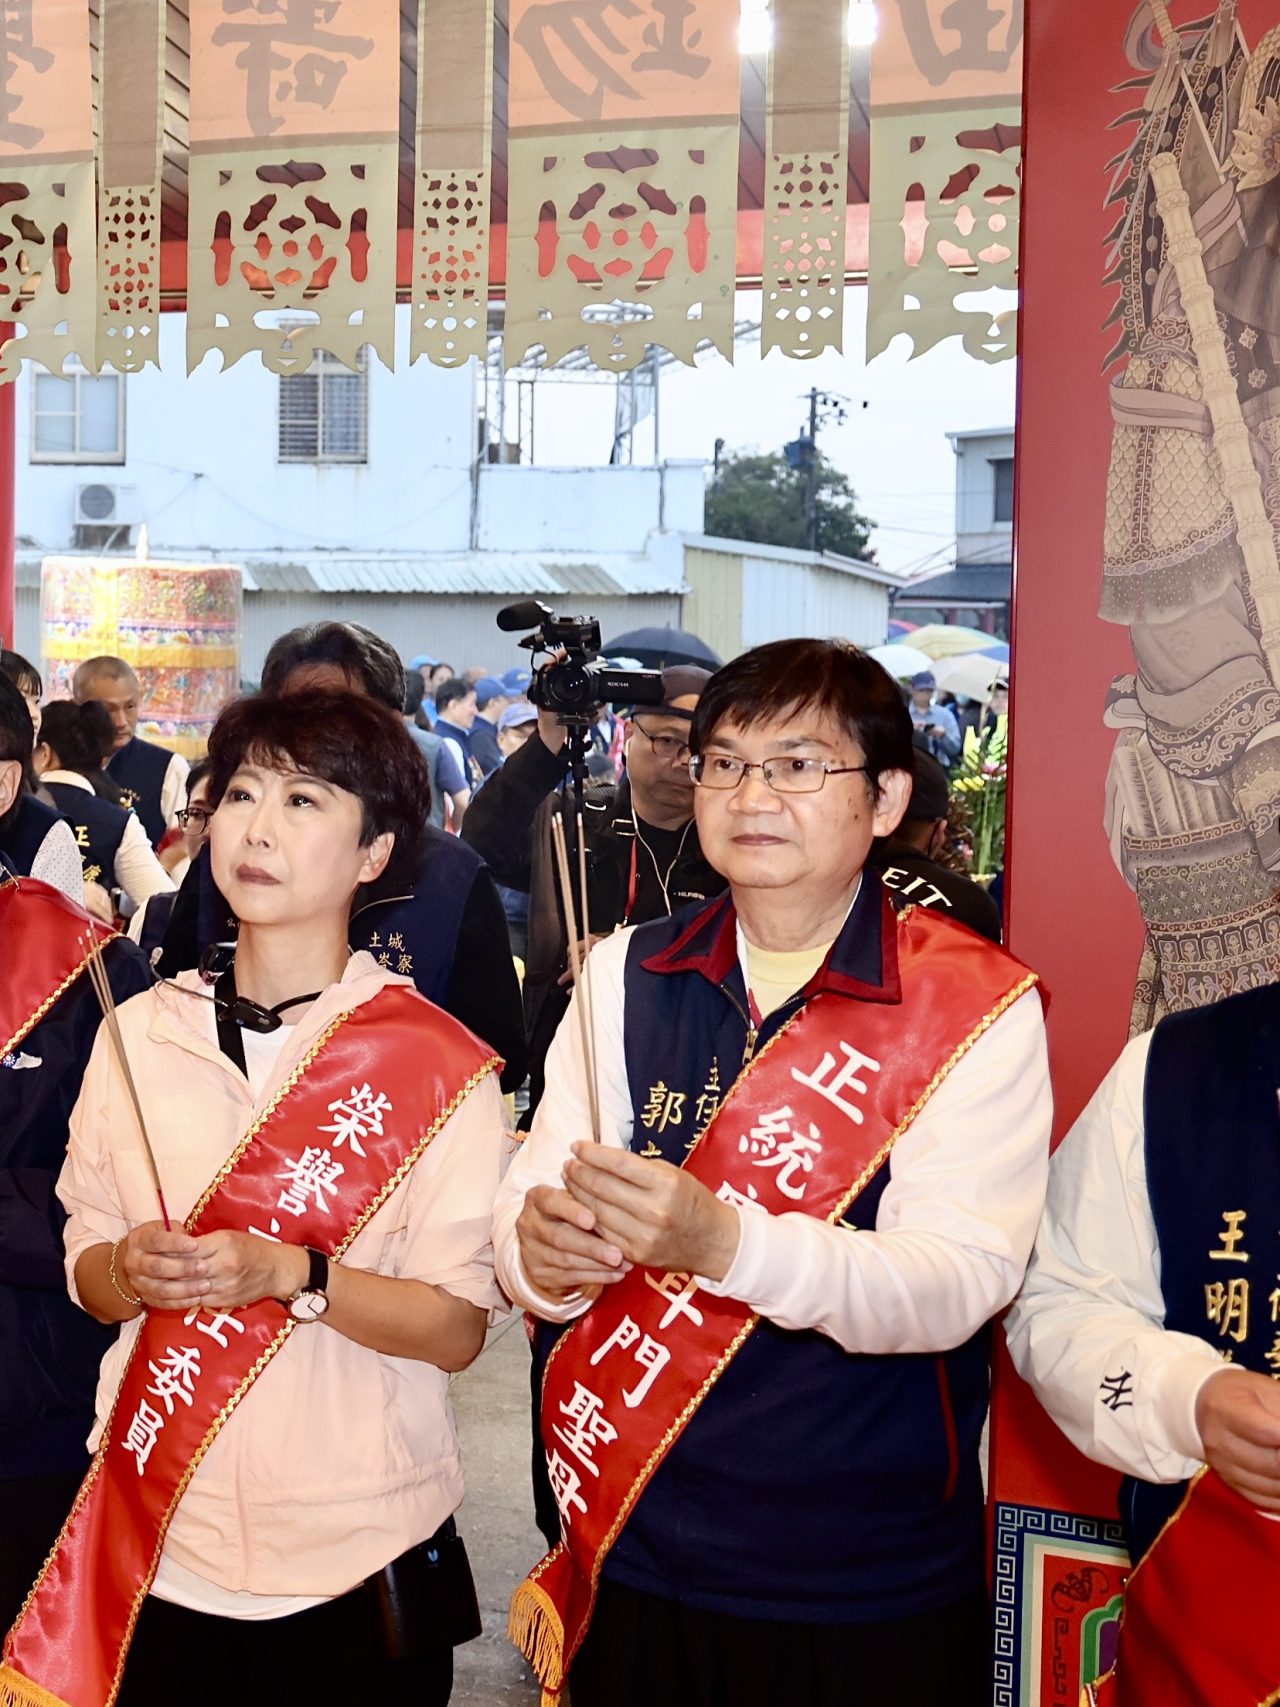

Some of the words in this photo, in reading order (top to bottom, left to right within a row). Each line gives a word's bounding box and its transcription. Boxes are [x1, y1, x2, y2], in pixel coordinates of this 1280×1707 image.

[368, 931, 406, 952] 土城
[120, 1081, 395, 1478] 榮譽任委員
[544, 1039, 883, 1545] 正統耳門聖母
[1204, 1209, 1250, 1362] 王明
